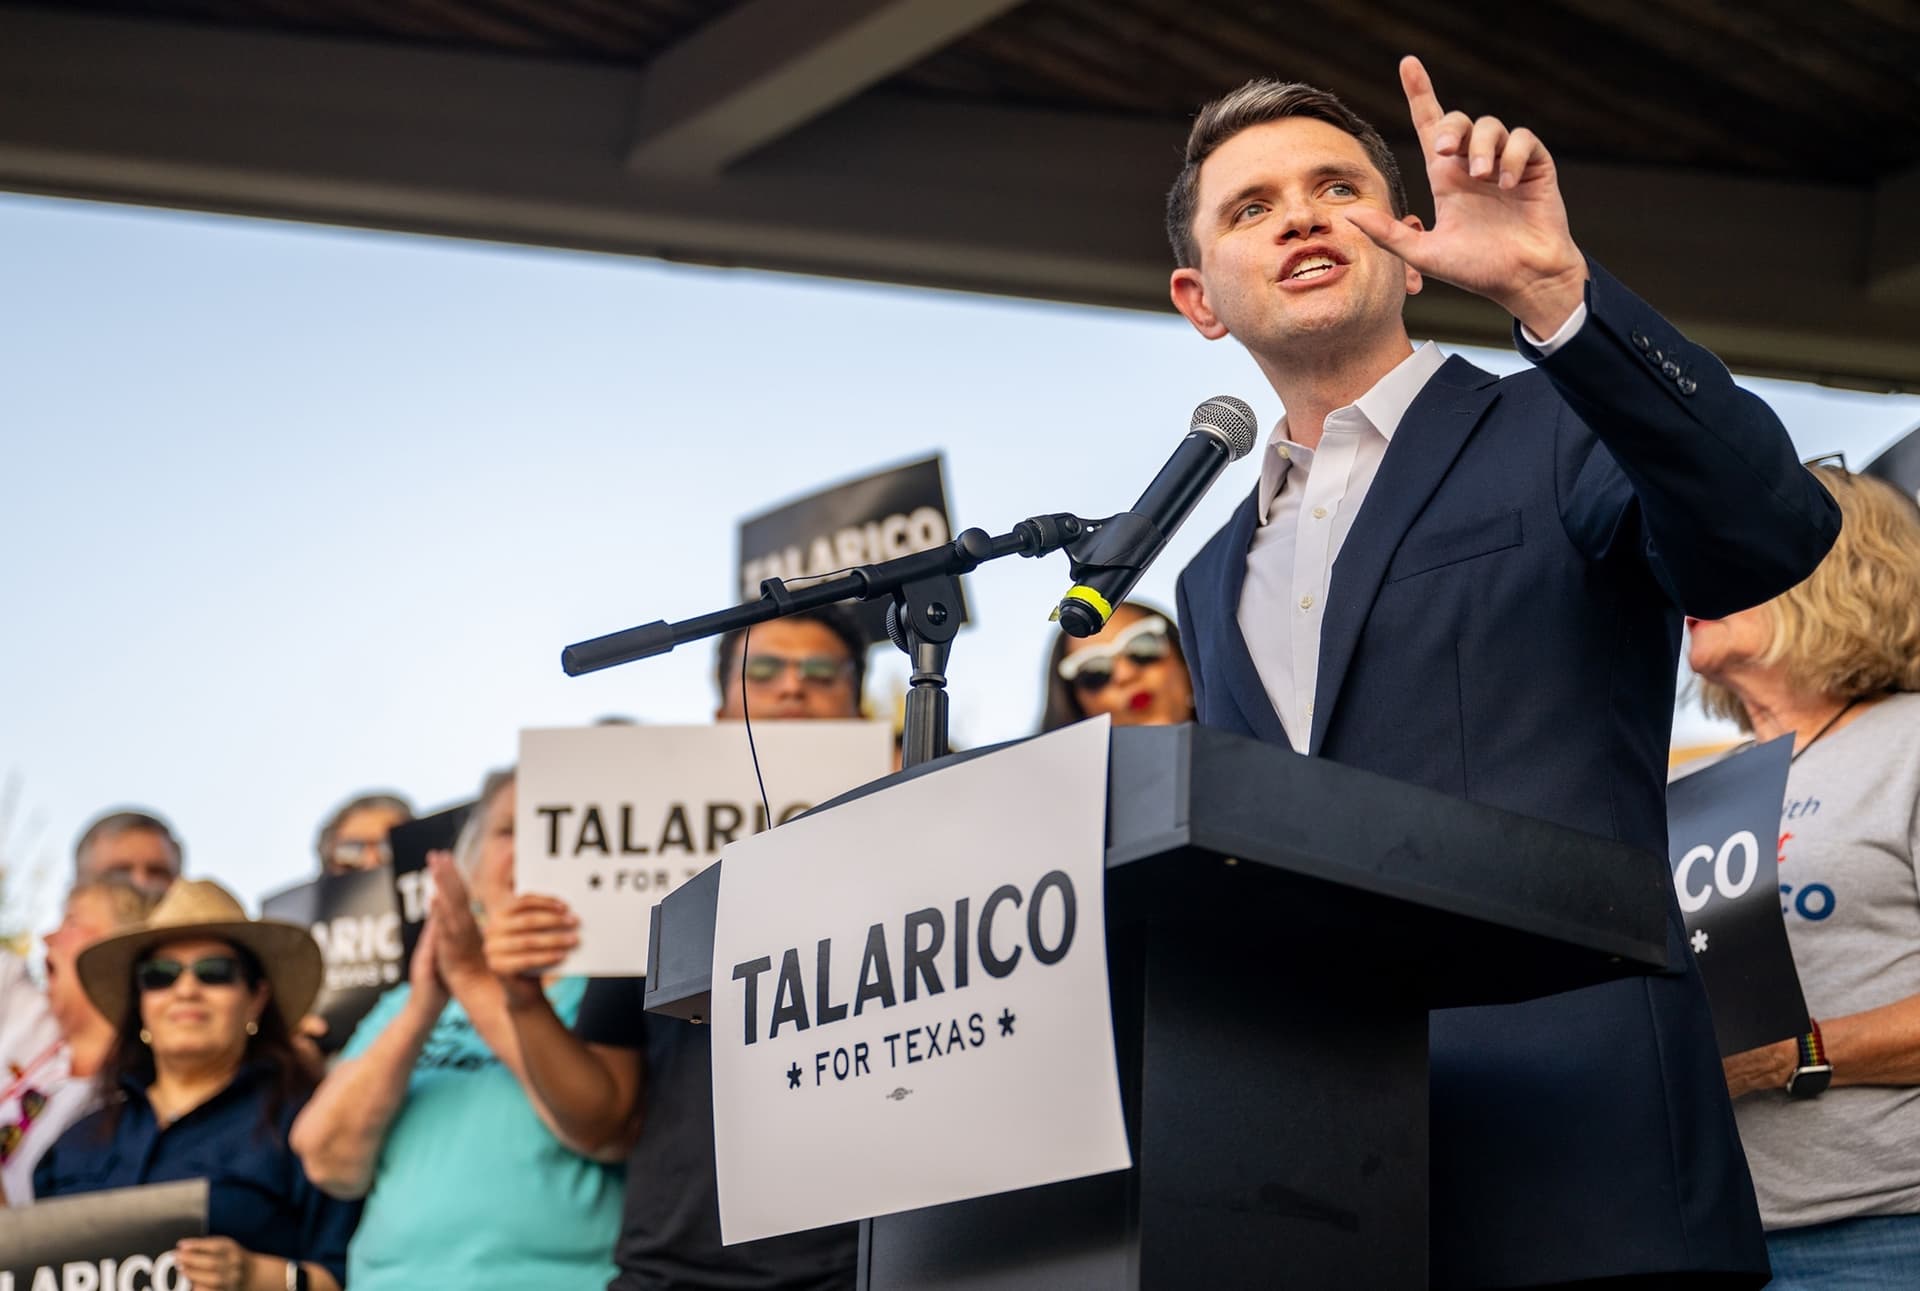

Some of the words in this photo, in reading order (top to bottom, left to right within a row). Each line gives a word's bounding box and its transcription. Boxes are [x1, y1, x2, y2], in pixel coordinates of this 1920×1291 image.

[615, 873, 669, 892] FOR
[732, 870, 1078, 1046] TALARICO
[815, 1042, 871, 1086] FOR
[884, 1013, 986, 1069] TEXAS
